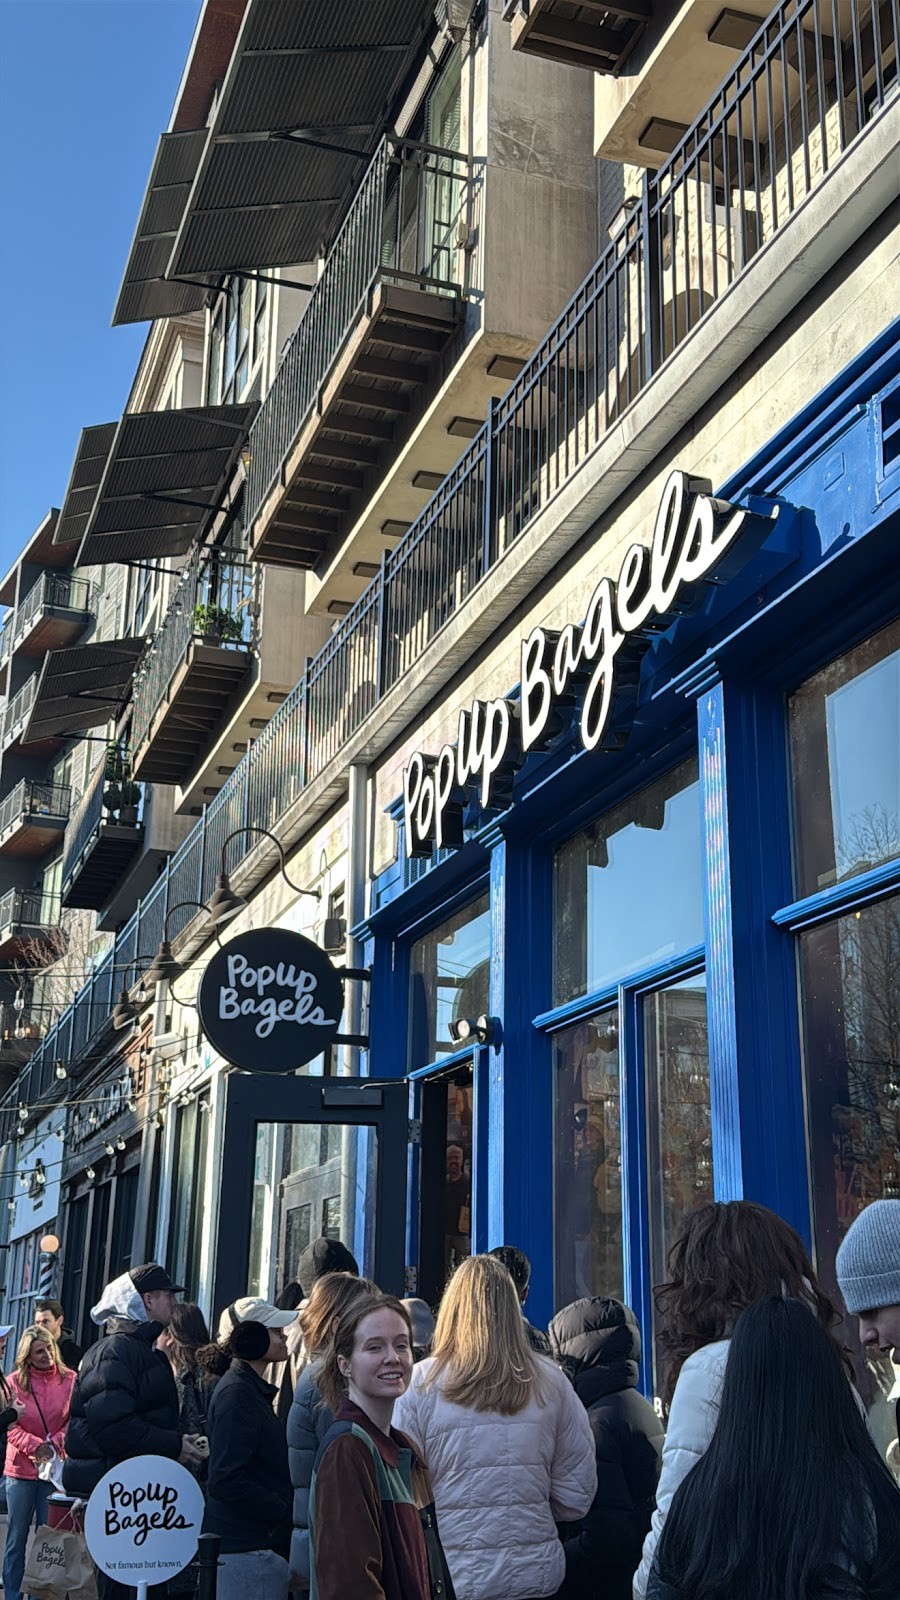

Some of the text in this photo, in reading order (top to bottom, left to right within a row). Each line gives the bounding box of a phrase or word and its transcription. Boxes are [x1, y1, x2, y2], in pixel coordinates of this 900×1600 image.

[519, 470, 746, 752] Bagels
[219, 986, 337, 1039] Bagels
[105, 1505, 194, 1546] Bagels
[105, 1560, 182, 1569] Not famous but known.
